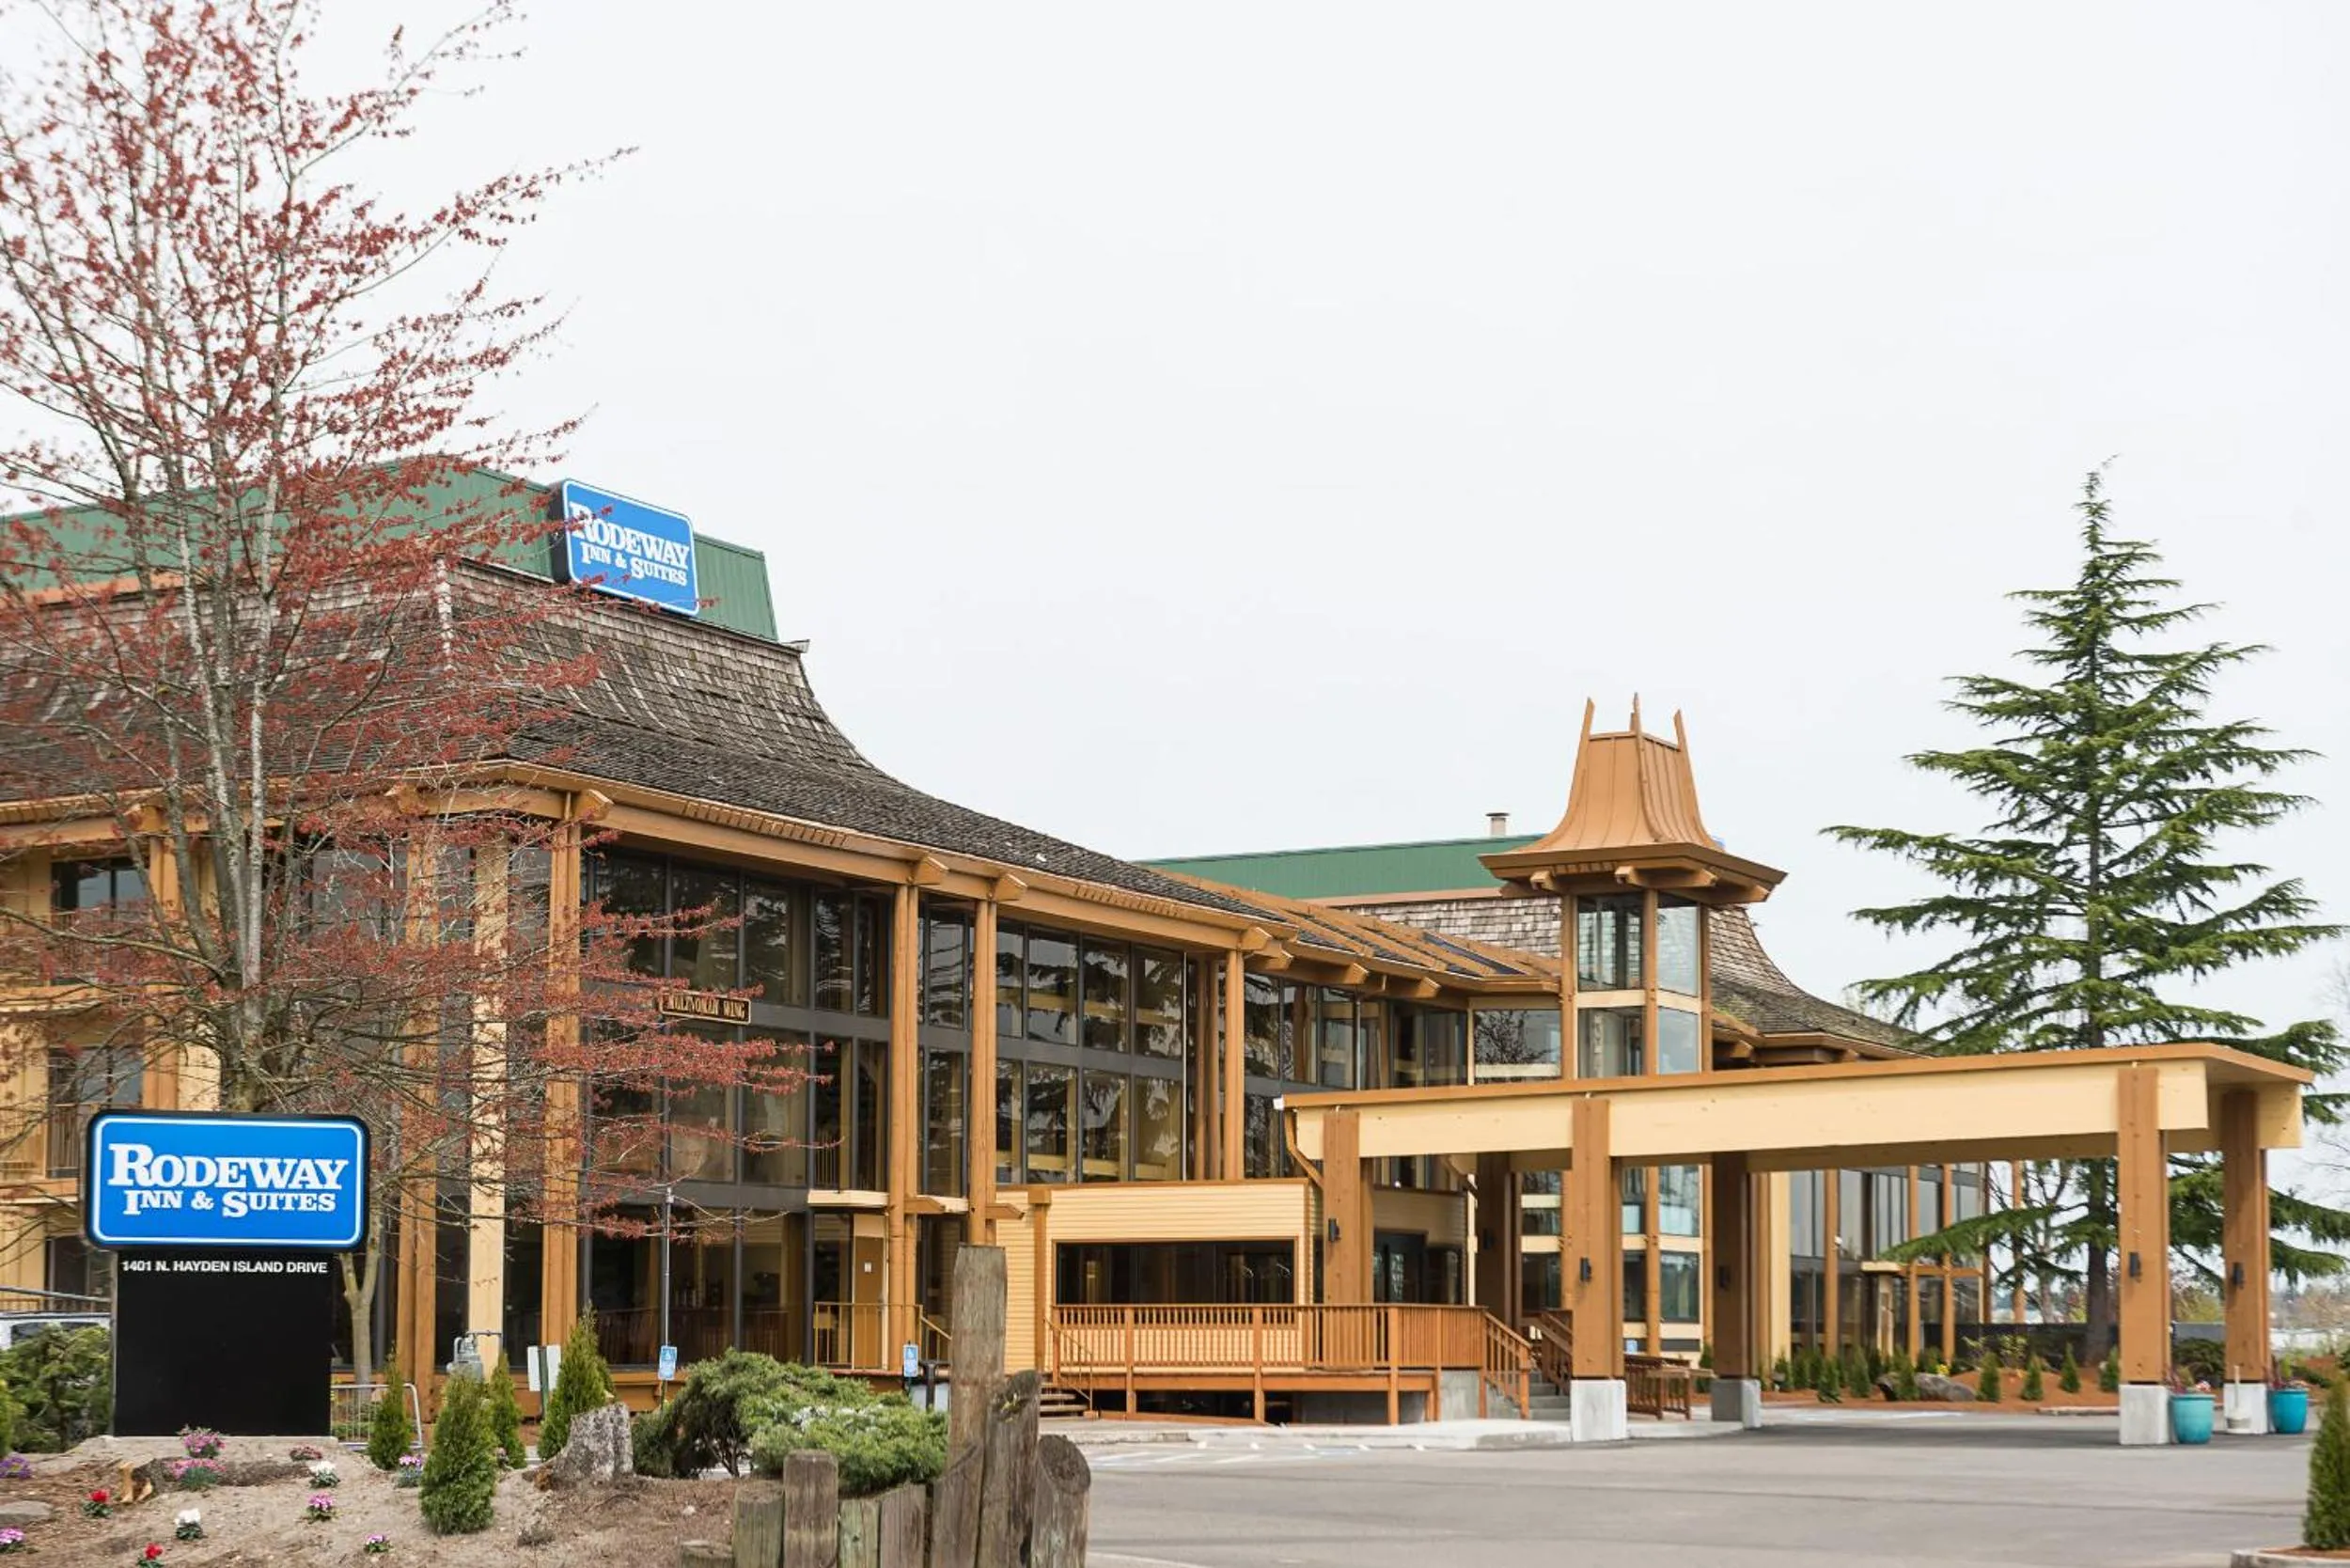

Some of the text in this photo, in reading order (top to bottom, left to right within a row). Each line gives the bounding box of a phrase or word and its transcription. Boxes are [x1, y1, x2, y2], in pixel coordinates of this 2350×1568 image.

[569, 501, 690, 570] RODEWAY
[580, 541, 688, 587] INN & SUITES
[723, 1000, 745, 1020] WING
[107, 1143, 349, 1190] RODEWAY
[123, 1189, 337, 1218] INN & SUITES
[121, 1261, 328, 1274] 1401 N. HAYDEN ISLAND DRIVE
